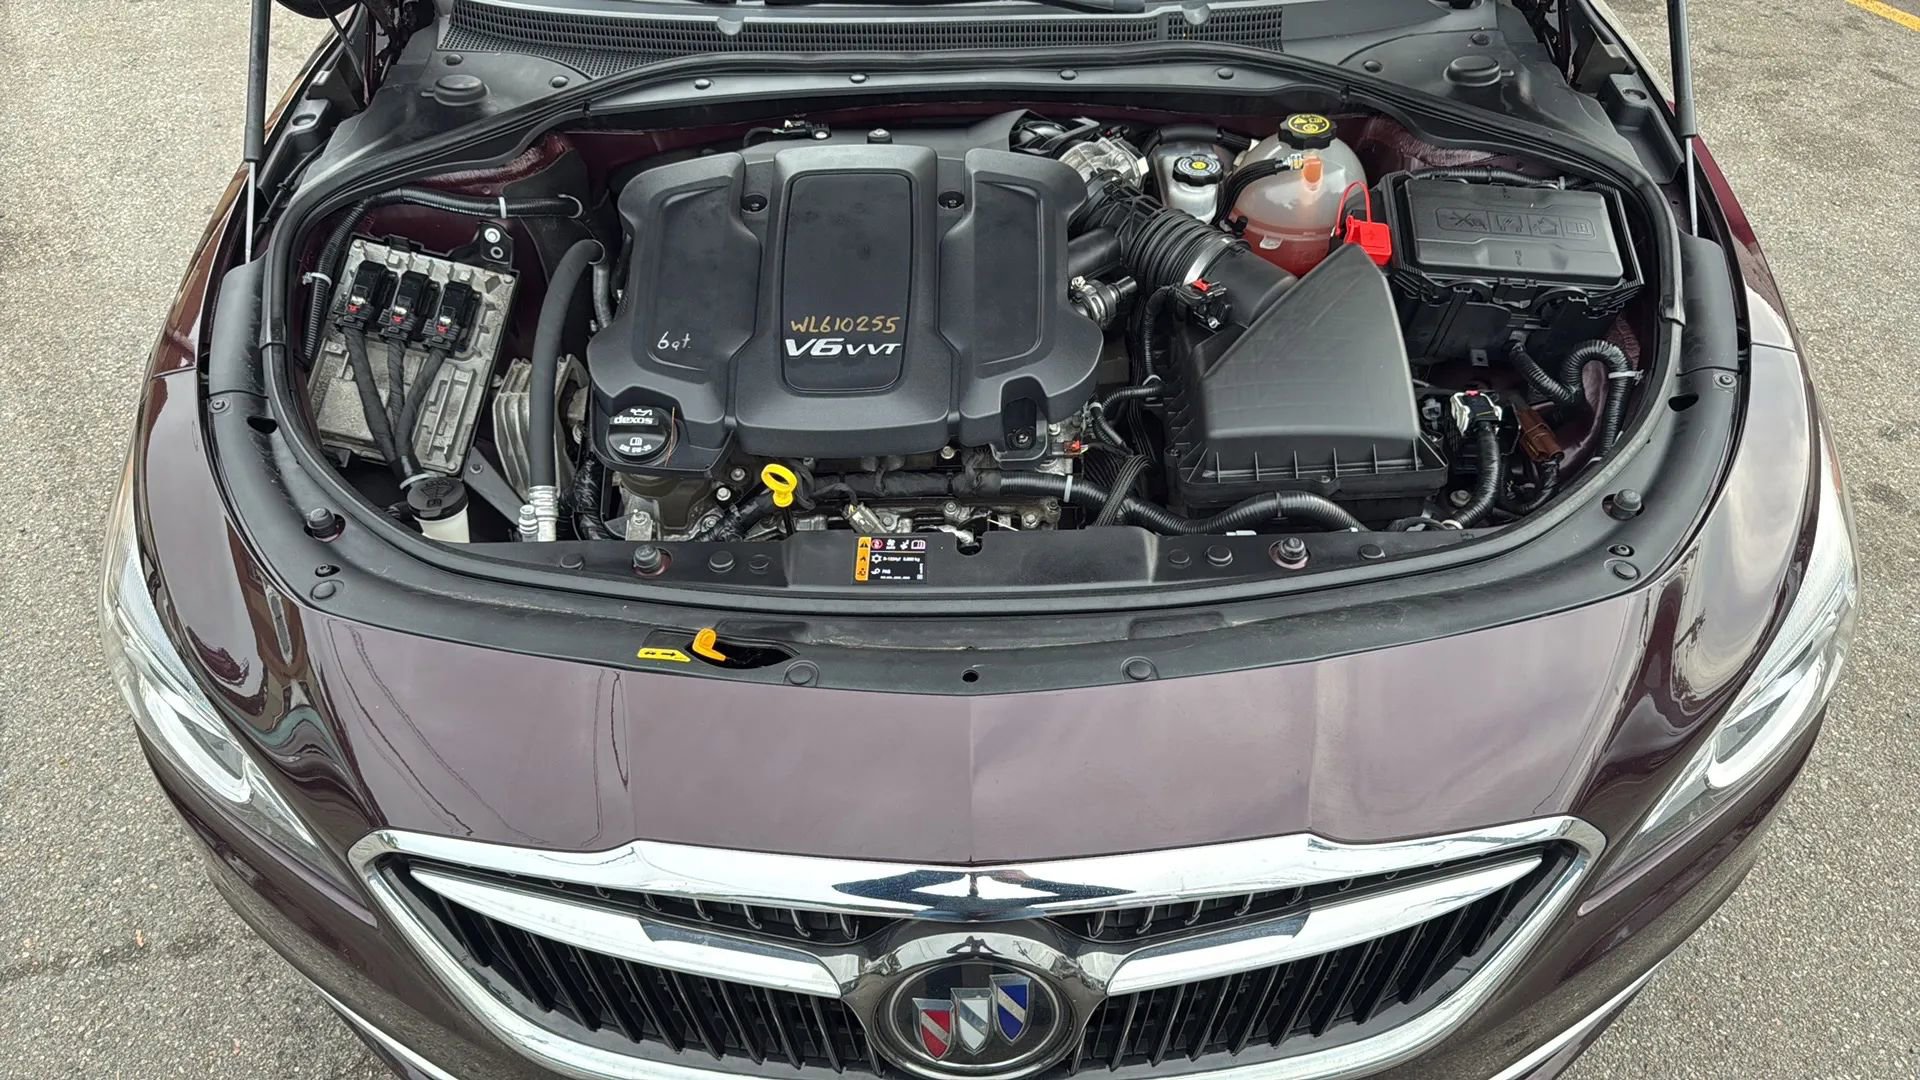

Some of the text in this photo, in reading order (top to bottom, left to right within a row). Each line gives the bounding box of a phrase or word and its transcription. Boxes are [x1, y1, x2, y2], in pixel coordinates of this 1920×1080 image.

[790, 315, 901, 333] WL610255
[785, 338, 901, 356] V6 VVT
[613, 415, 654, 425] dexos
